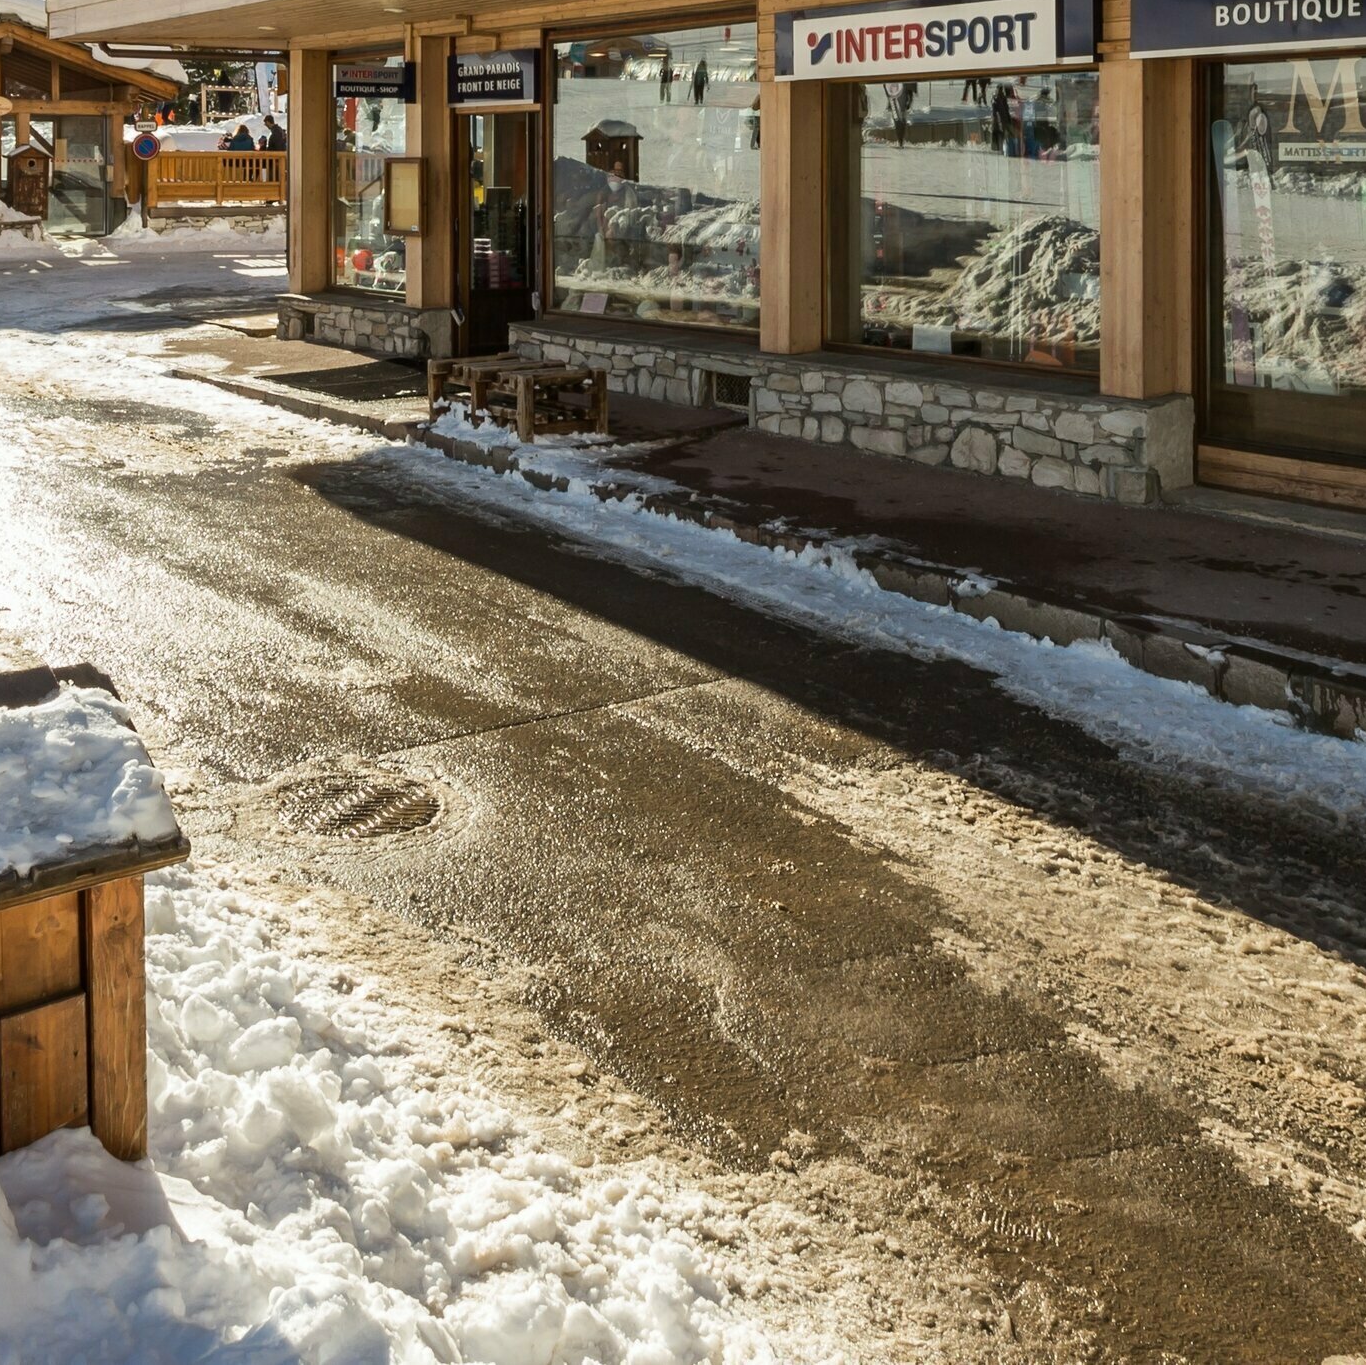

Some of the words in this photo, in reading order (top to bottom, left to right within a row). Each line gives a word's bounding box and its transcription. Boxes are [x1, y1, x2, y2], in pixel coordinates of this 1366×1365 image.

[836, 12, 1038, 64] INTERSPORT
[349, 69, 399, 80] INTERSPORT
[458, 64, 485, 78] GRAND
[486, 62, 521, 74] PARADIS
[340, 85, 377, 93] BOUTIQUE
[379, 85, 399, 94] SHOP
[458, 81, 483, 93] FRONT
[485, 80, 495, 91] DE
[496, 78, 521, 91] NEIGE
